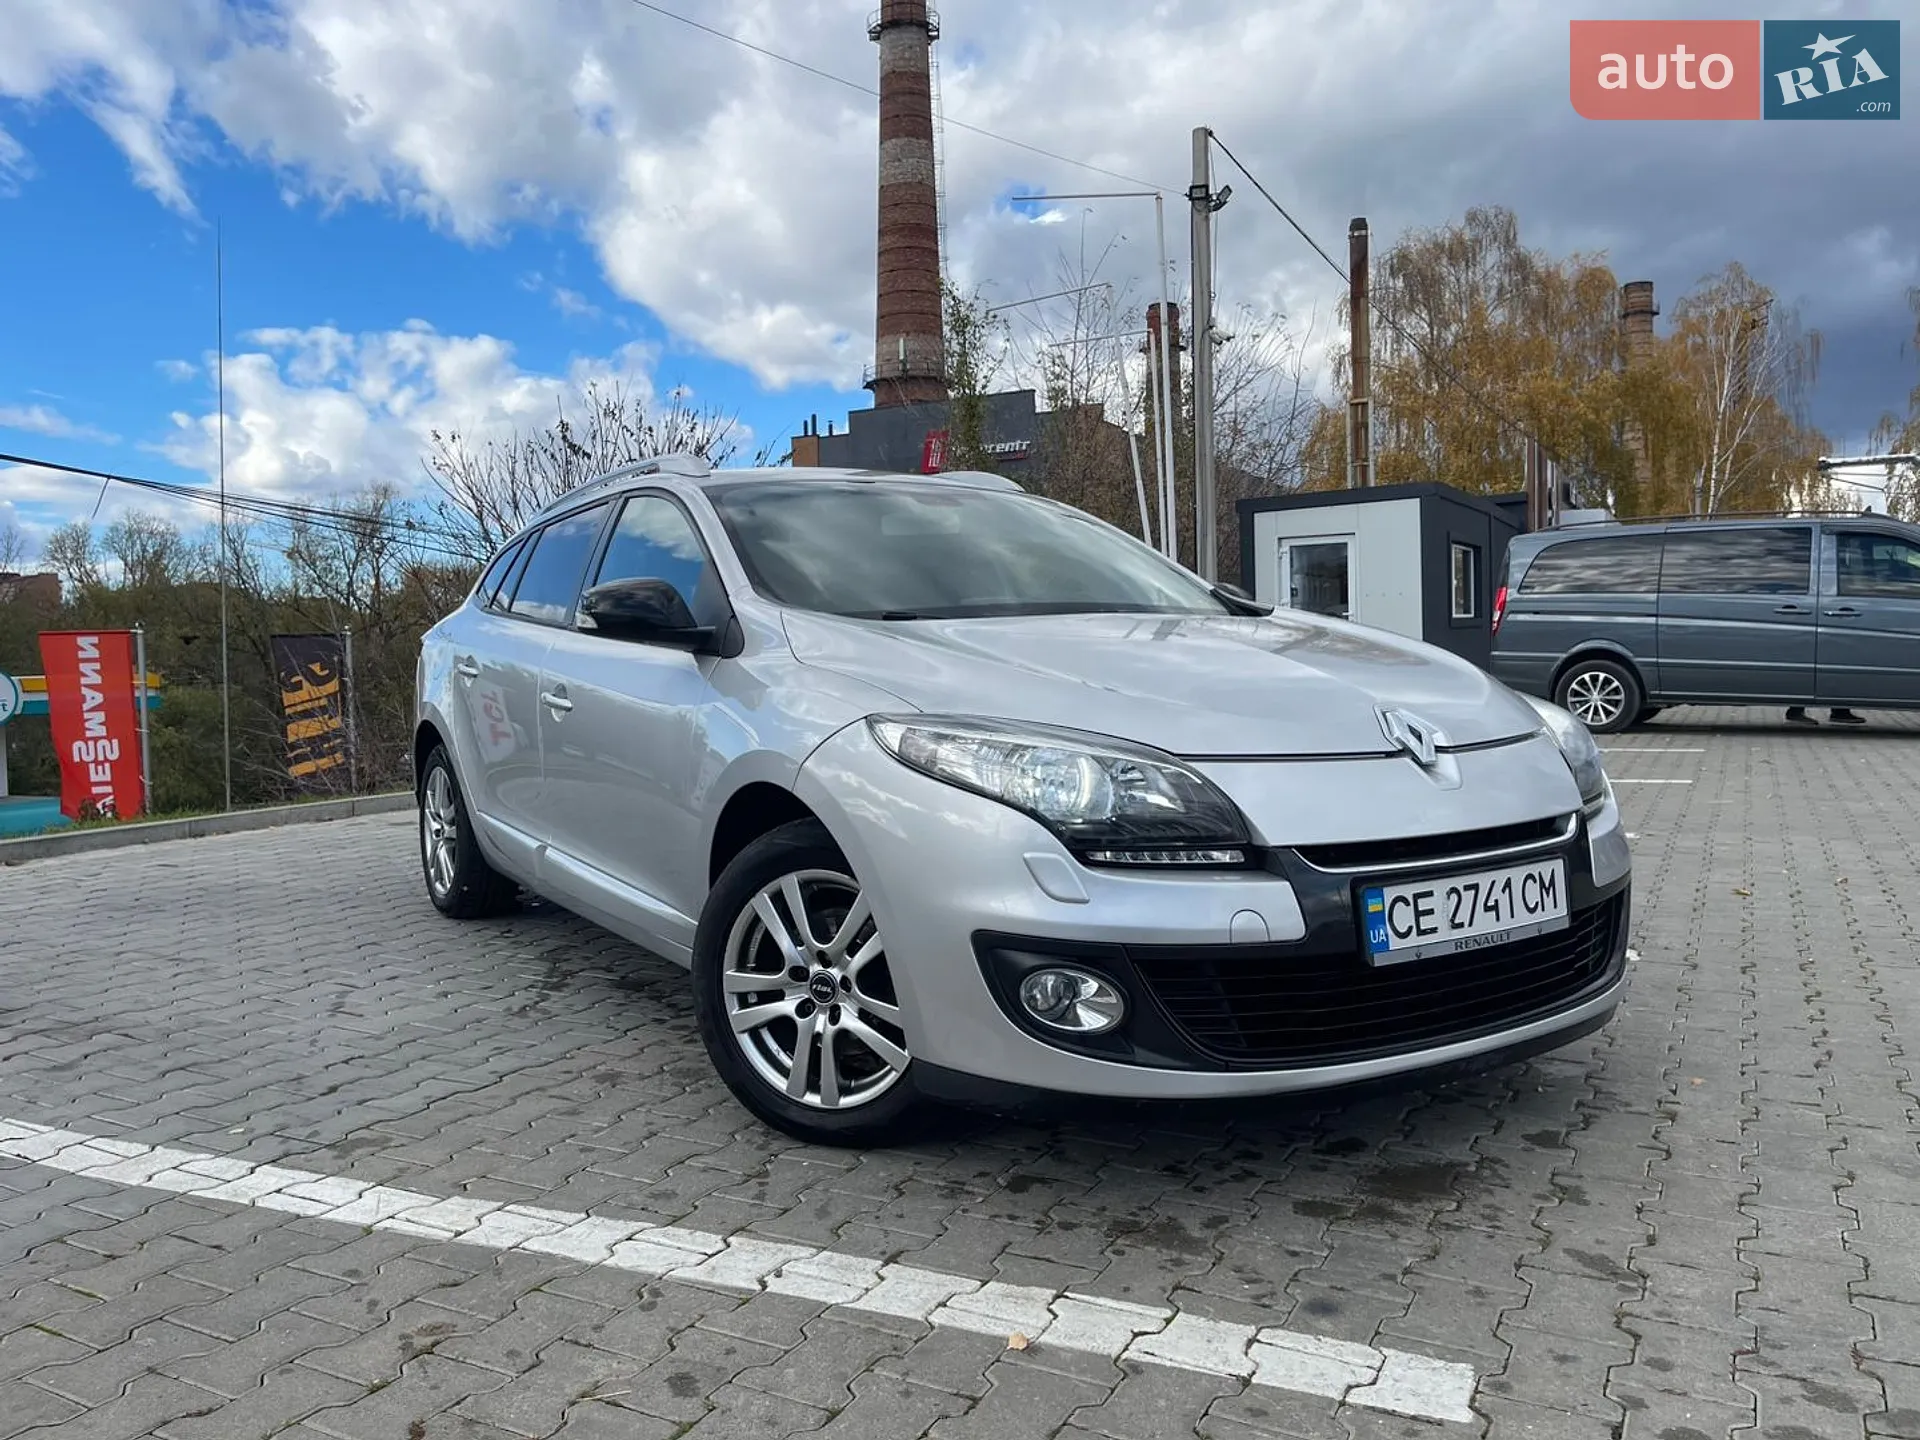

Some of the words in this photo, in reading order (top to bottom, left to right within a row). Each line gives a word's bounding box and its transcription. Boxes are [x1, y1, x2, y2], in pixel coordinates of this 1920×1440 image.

[1387, 889, 1439, 940] CE
[1446, 876, 1515, 930] 2741
[1521, 868, 1558, 914] CM
[1370, 928, 1387, 944] UA
[1454, 931, 1512, 951] RENAULT
